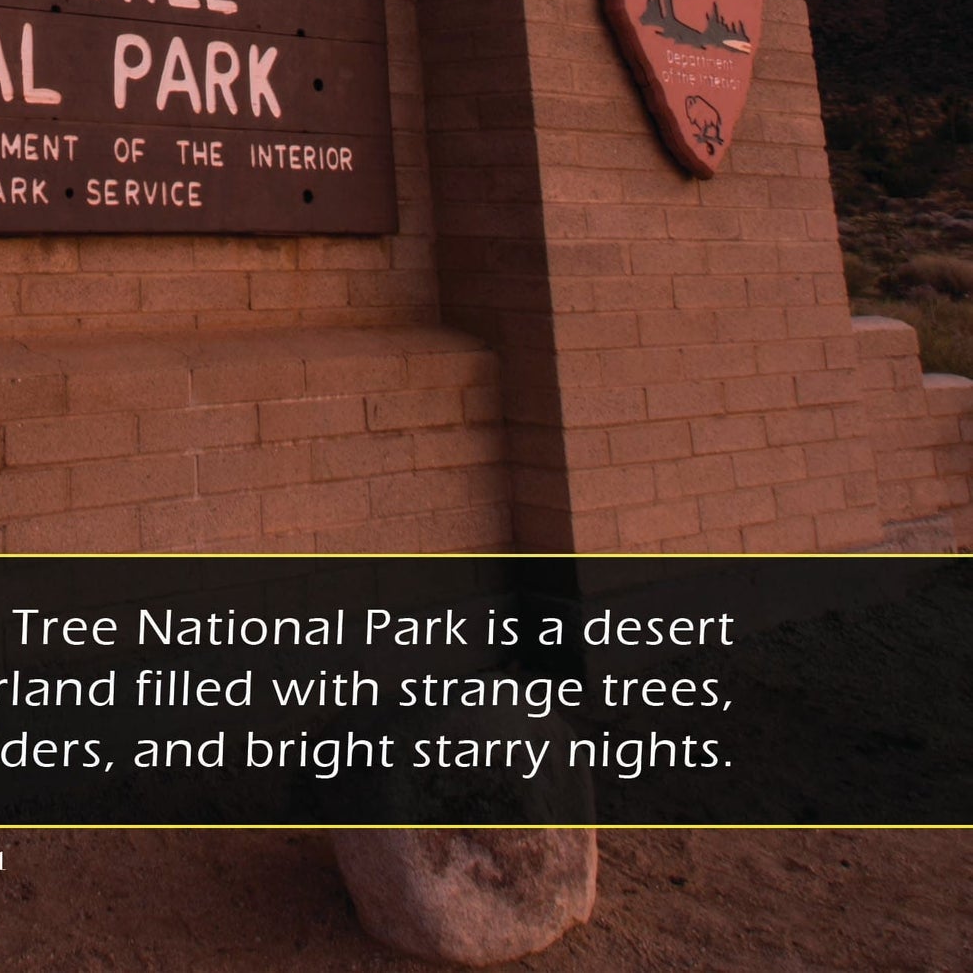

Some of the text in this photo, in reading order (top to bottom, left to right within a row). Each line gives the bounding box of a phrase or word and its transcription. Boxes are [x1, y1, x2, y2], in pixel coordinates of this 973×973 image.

[114, 34, 281, 118] PARK
[114, 138, 145, 163] OF
[177, 140, 223, 166] THE
[251, 145, 352, 170] INTERIOR
[87, 179, 202, 206] SERVICE
